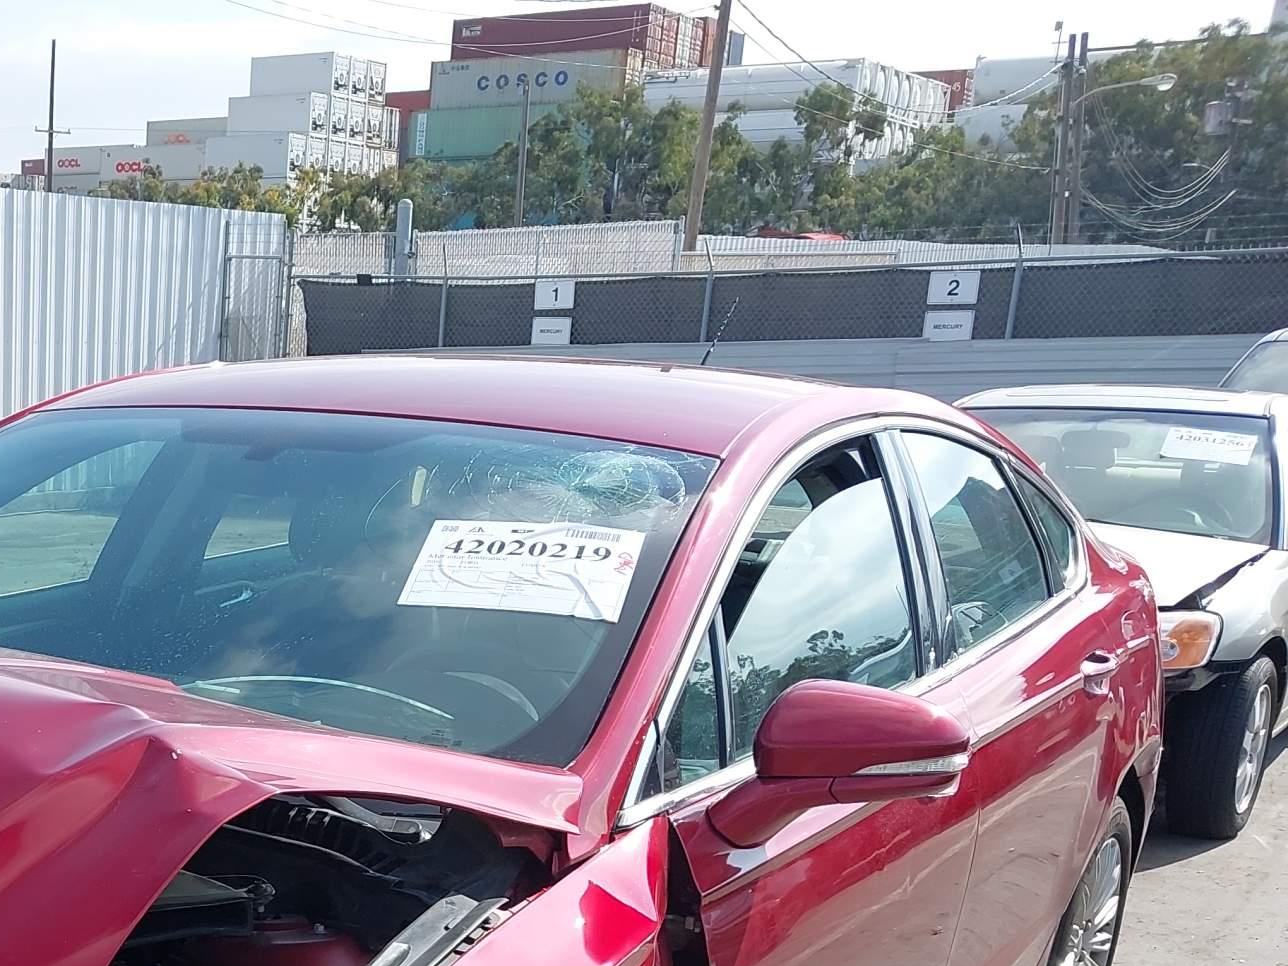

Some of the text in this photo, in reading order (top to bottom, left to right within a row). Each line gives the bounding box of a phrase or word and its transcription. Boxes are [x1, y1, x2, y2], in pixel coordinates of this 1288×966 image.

[477, 70, 568, 91] COSCO
[57, 159, 81, 168] OOCL
[116, 161, 144, 173] OOCL
[552, 287, 559, 302] 1
[947, 279, 960, 296] 2
[444, 538, 612, 562] 42020219
